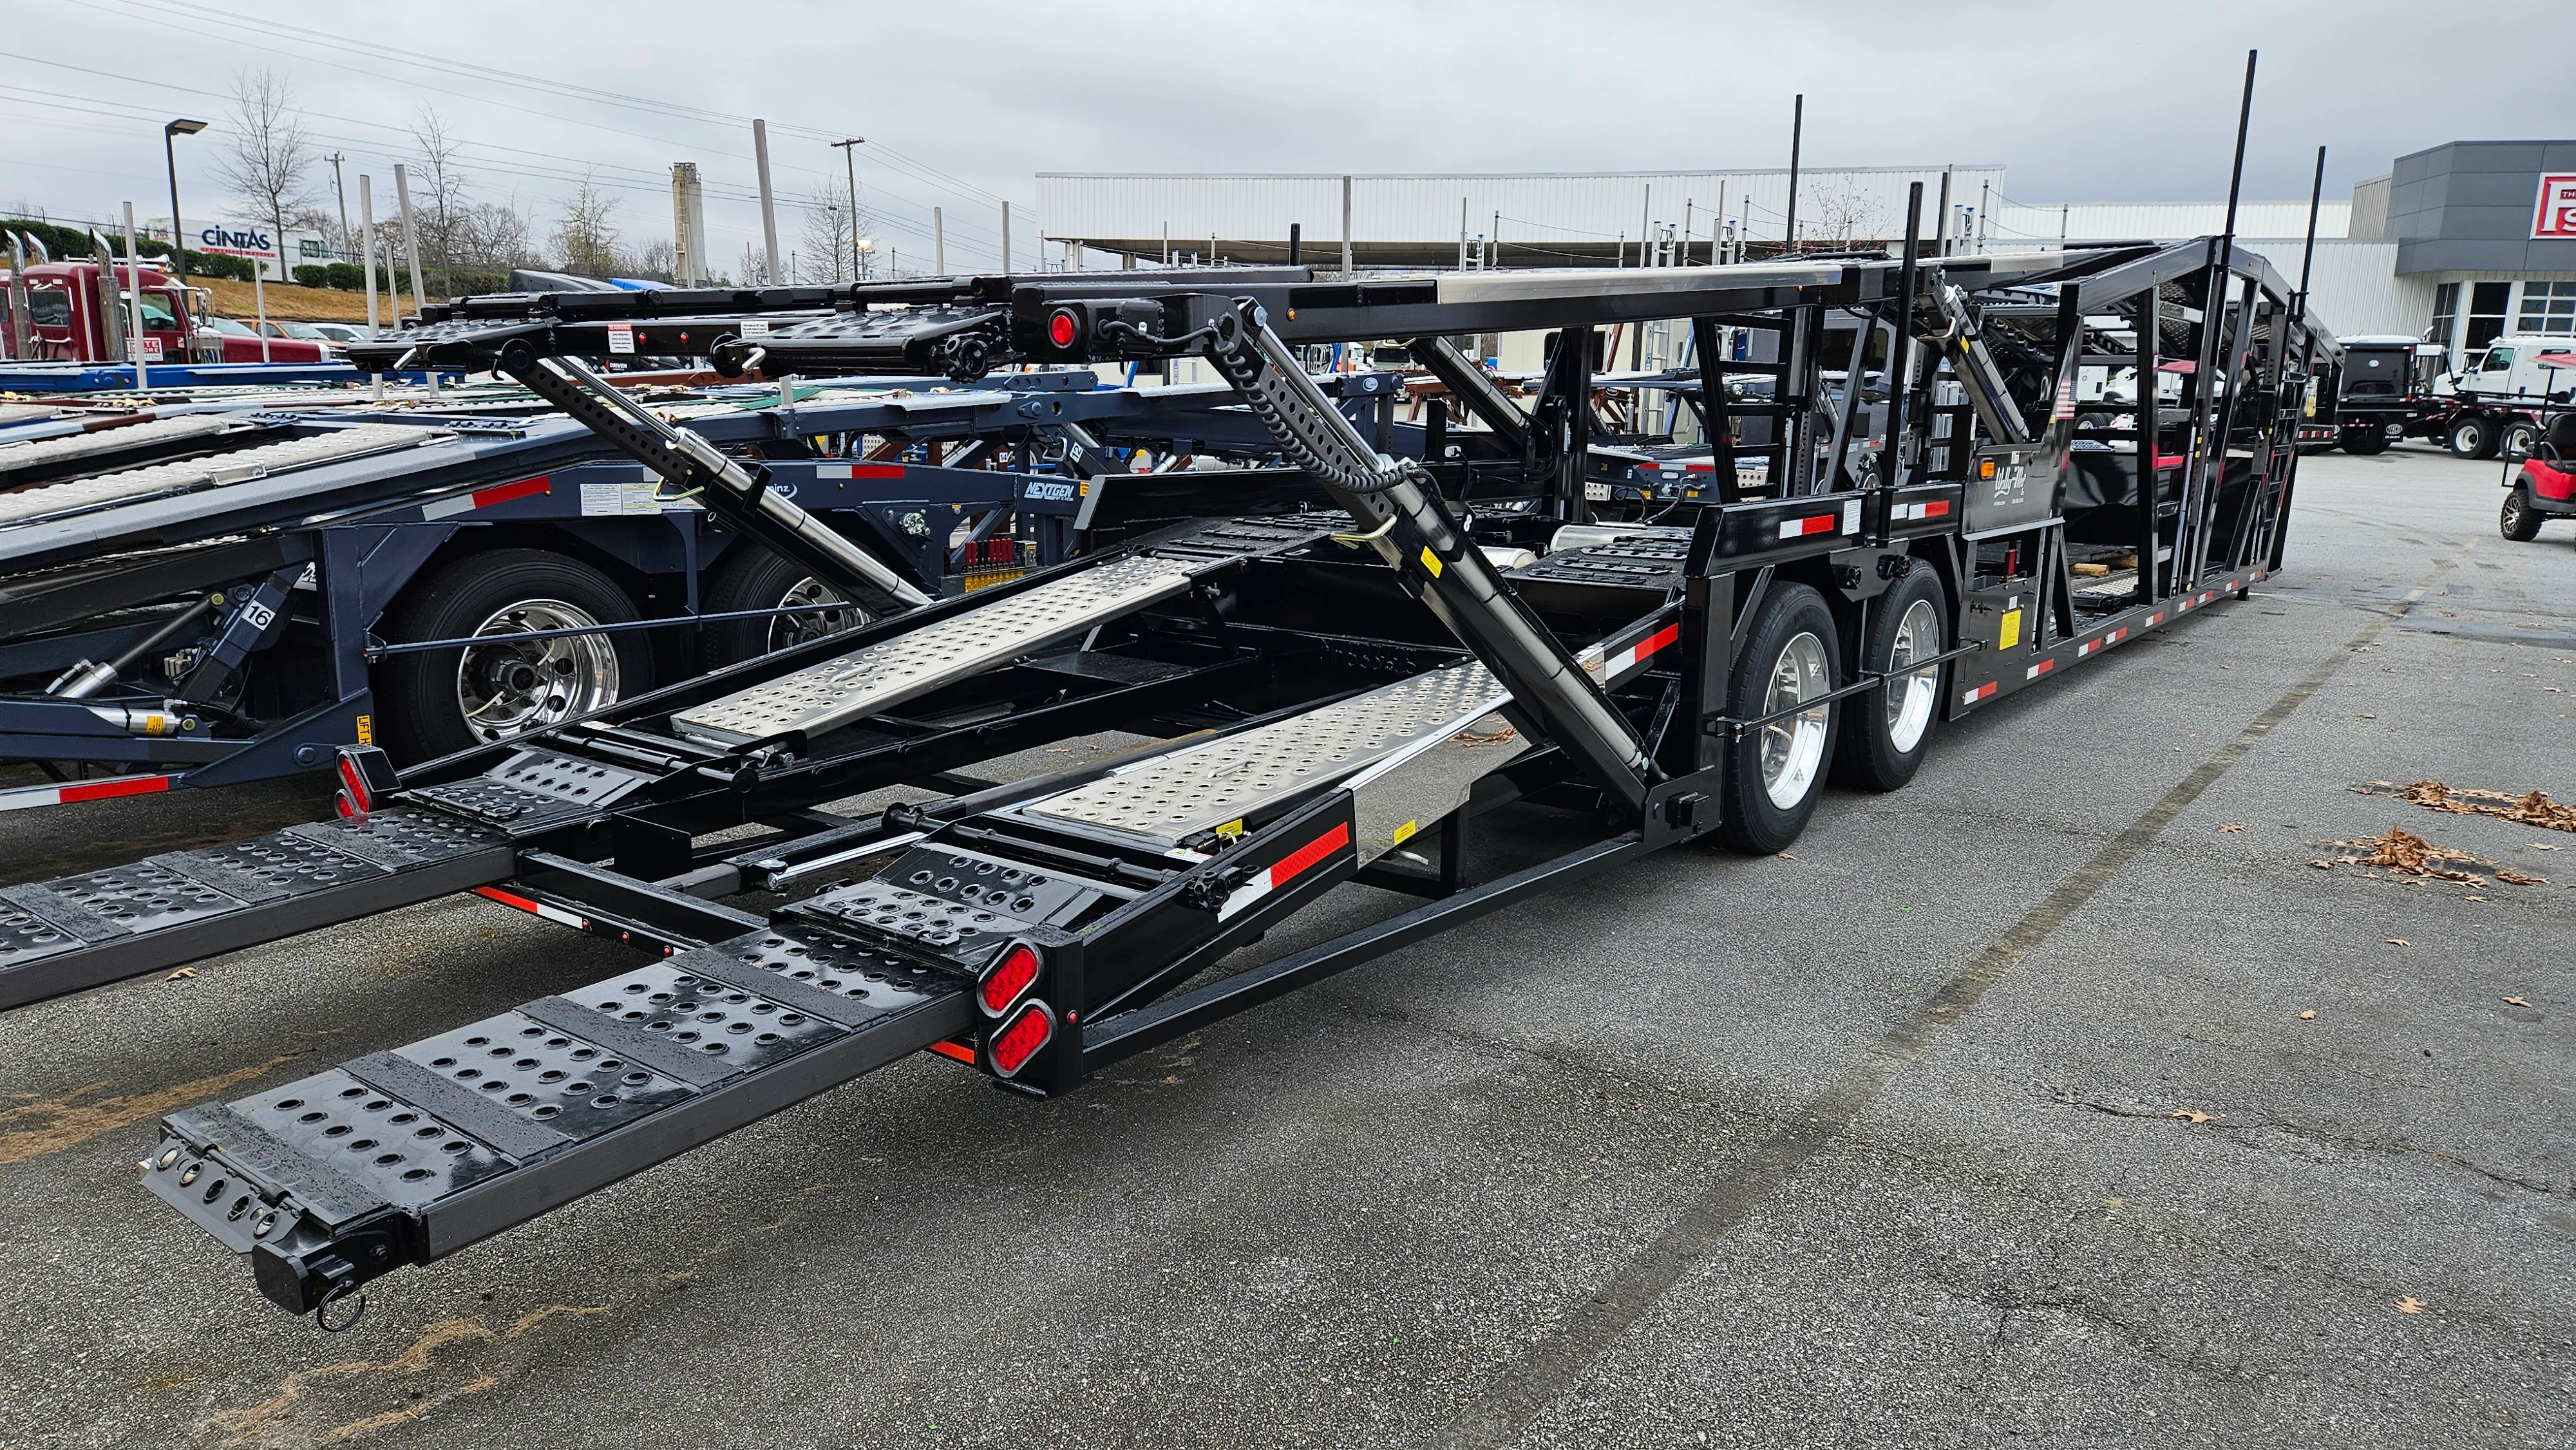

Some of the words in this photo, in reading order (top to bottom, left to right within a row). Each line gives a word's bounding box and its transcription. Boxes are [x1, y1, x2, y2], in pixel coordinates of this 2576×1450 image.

[1072, 445, 1081, 460] 12
[1024, 482, 1074, 500] NEXTGEN
[1463, 514, 1472, 532] 8
[249, 605, 271, 626] 16
[358, 717, 370, 734] LIFT
